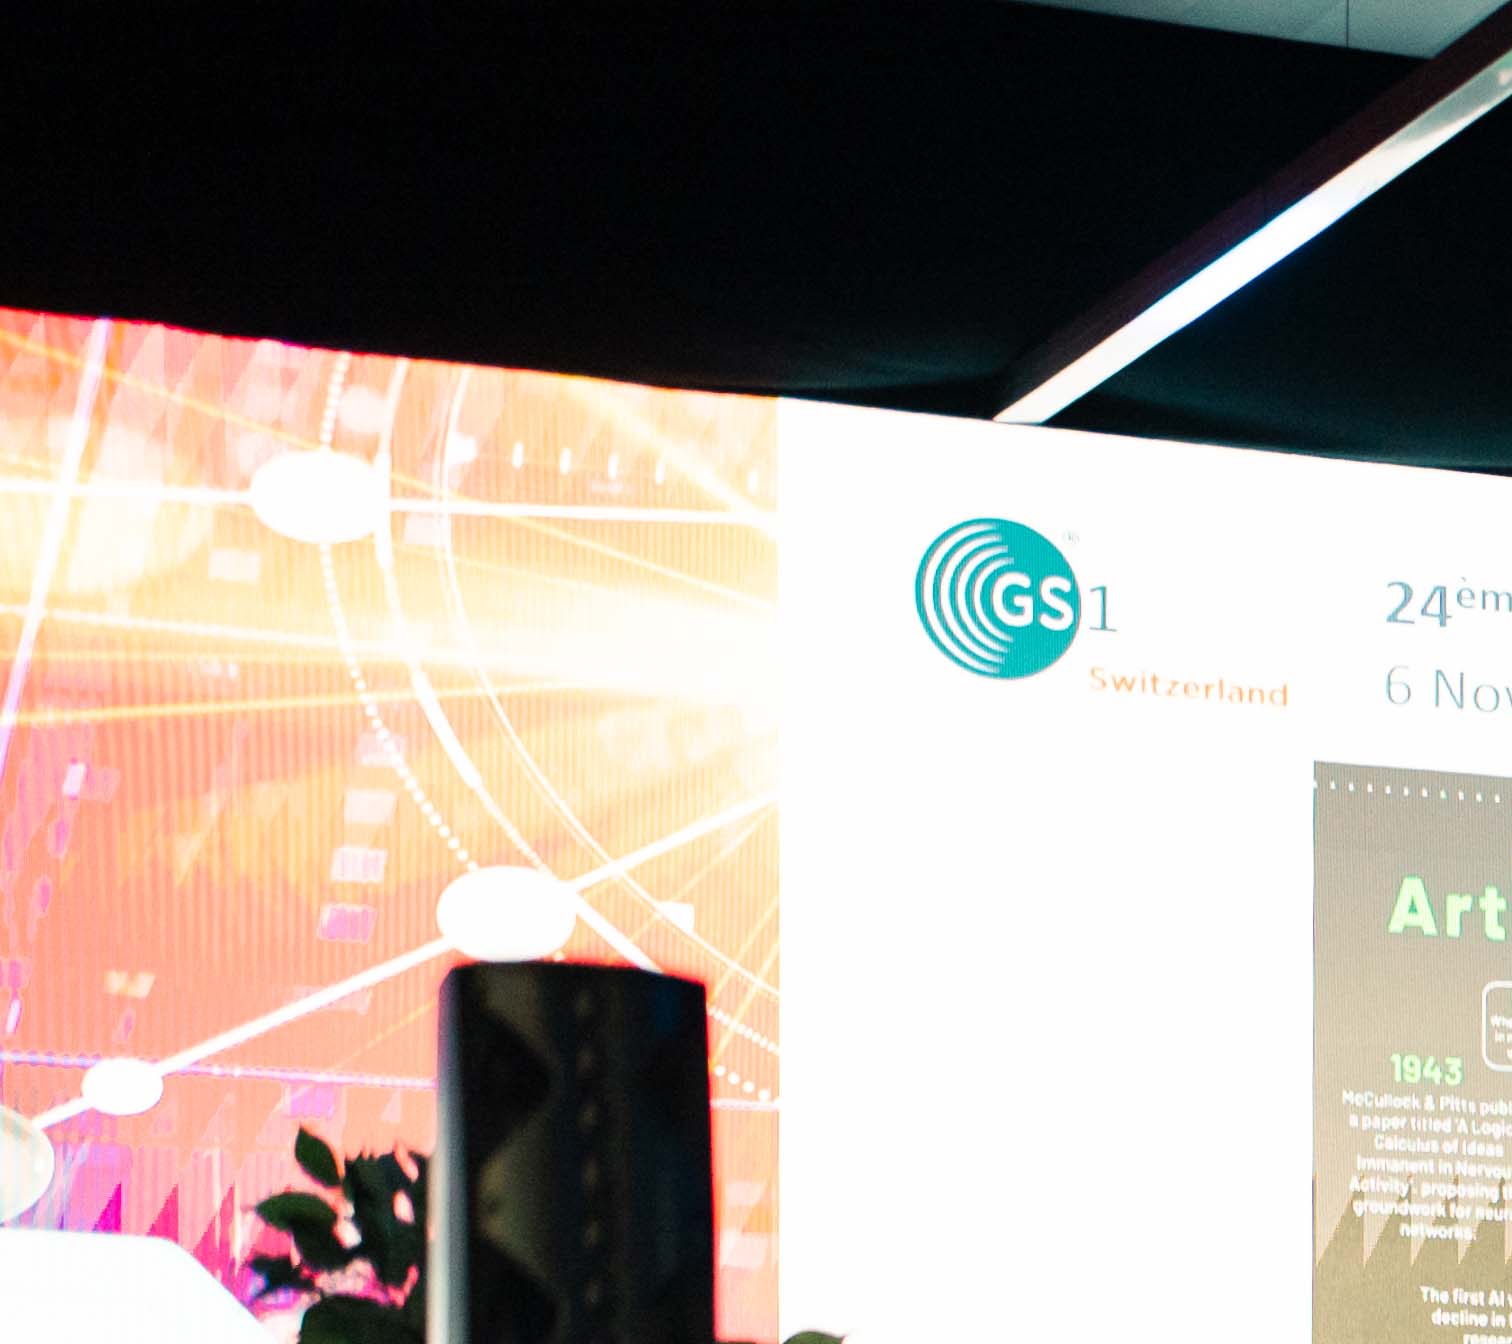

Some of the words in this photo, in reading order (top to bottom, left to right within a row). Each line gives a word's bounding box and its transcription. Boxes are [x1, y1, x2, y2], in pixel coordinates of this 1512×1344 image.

[992, 570, 1118, 632] GS1
[1090, 666, 1289, 707] Switzerland
[1385, 664, 1412, 705] 6
[1390, 1052, 1465, 1086] 1943
